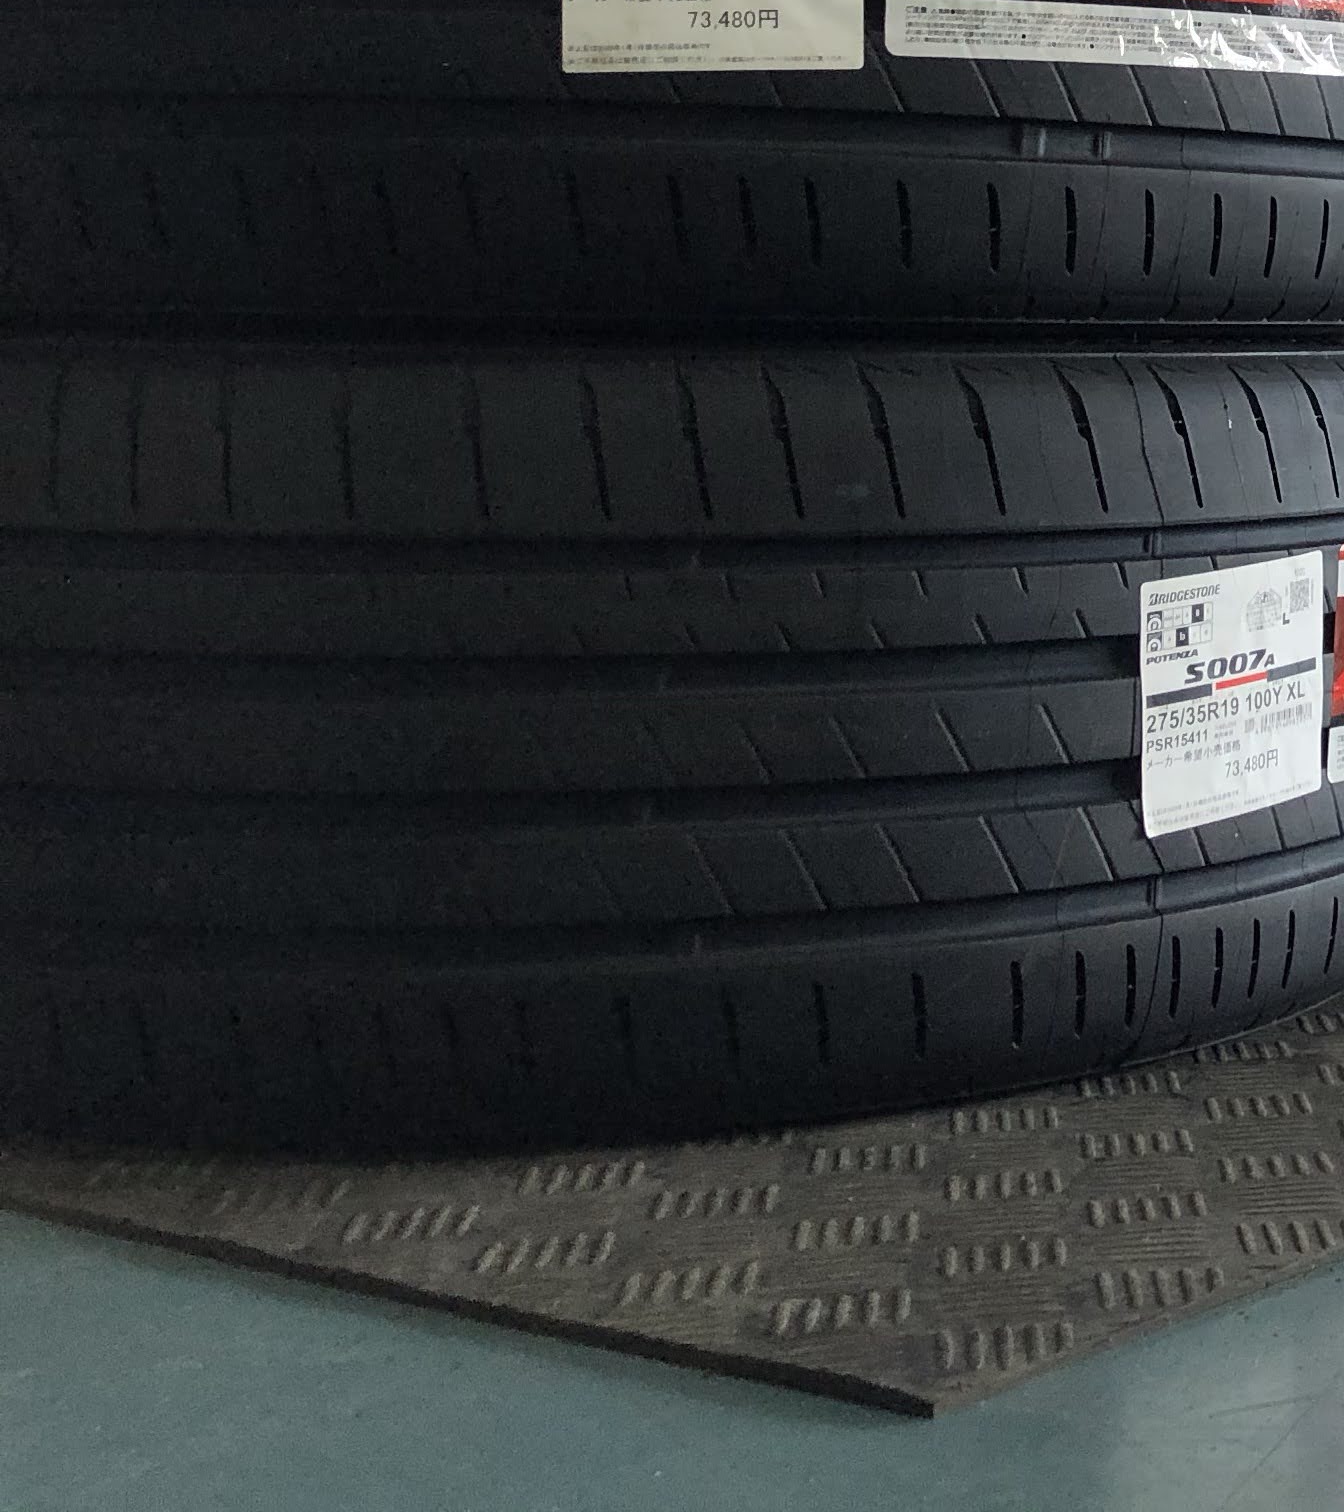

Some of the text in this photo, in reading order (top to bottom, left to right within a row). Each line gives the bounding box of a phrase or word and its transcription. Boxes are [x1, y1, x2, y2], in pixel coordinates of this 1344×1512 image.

[688, 9, 779, 30] 73,480円
[1148, 584, 1221, 607] BRIDGESTONE
[1282, 612, 1290, 626] L
[1146, 649, 1199, 665] POTENZA
[1184, 649, 1275, 685] S007A
[1147, 697, 1239, 734] 275/35R19
[1245, 686, 1284, 713] 100Y
[1287, 681, 1306, 702] XL
[1146, 729, 1209, 753] PSR15411
